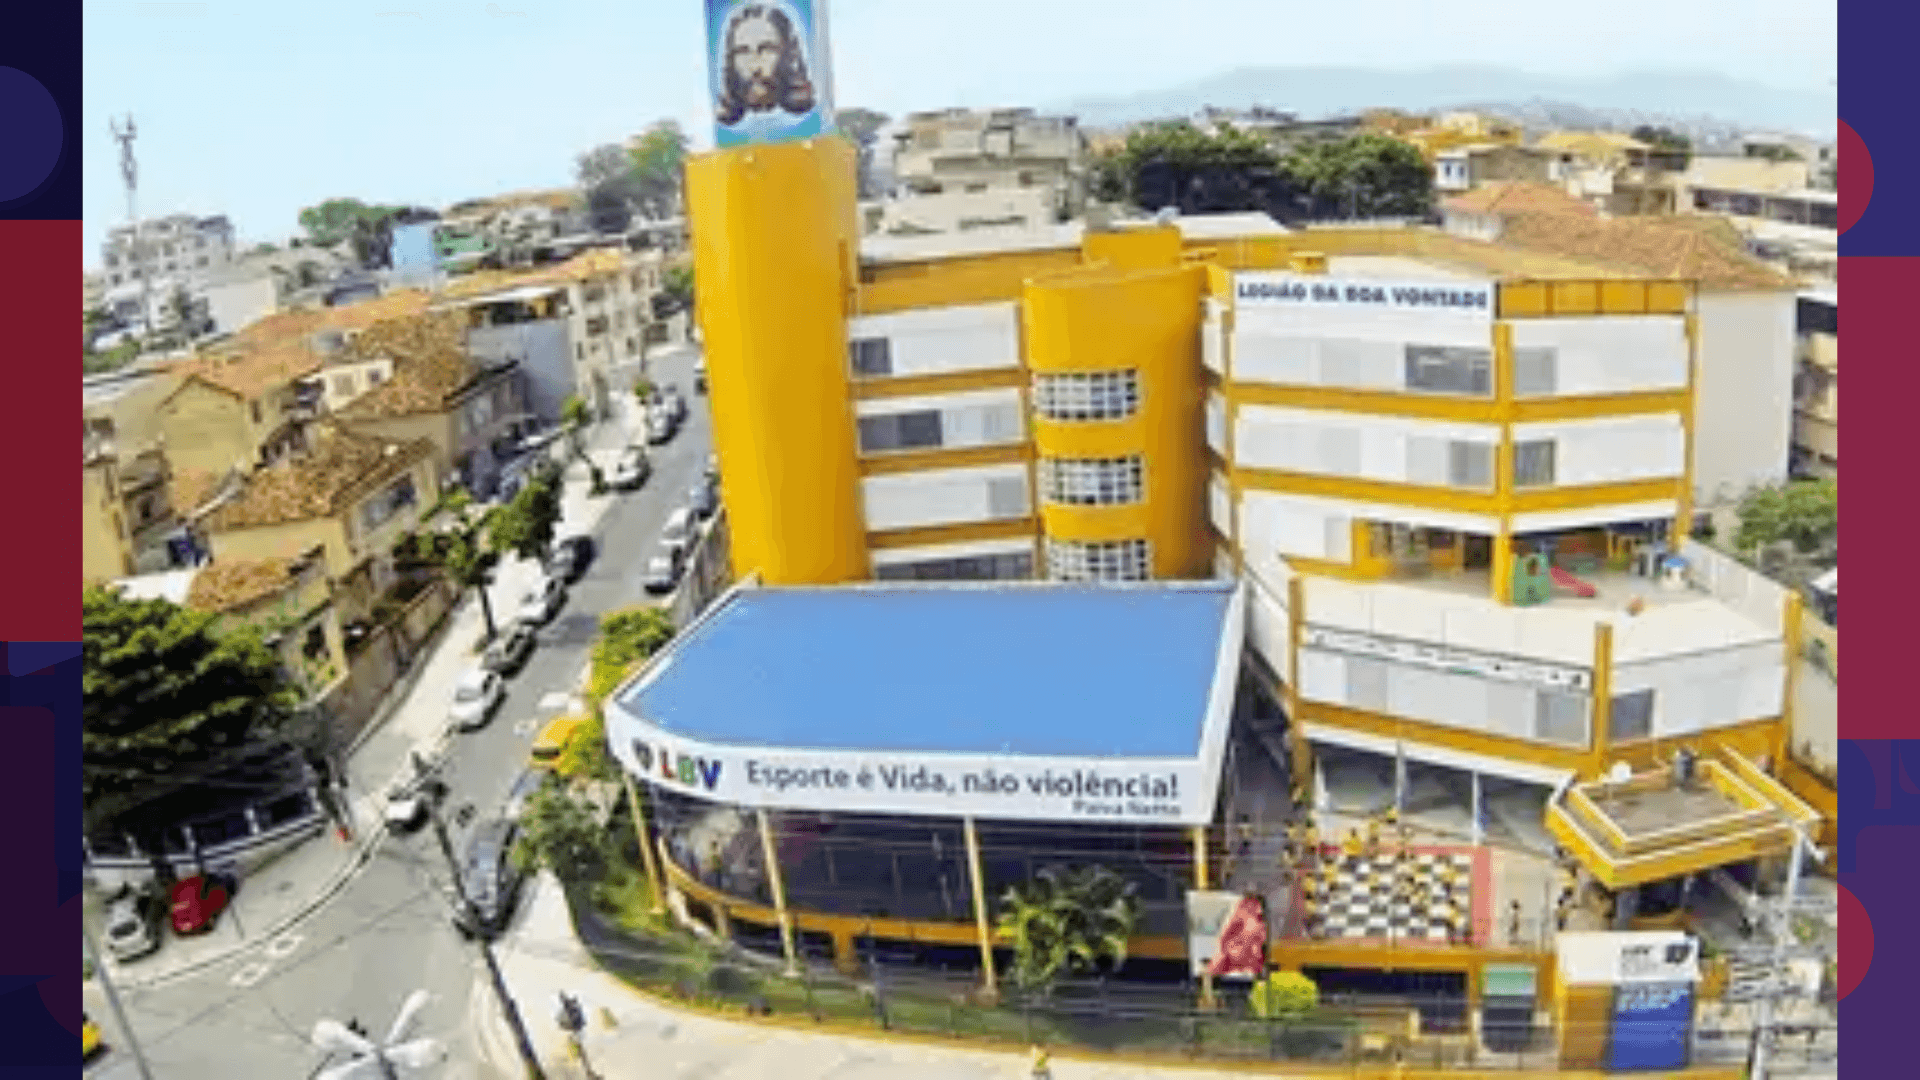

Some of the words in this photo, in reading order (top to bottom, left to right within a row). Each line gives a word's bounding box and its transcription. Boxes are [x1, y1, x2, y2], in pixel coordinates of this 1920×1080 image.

[659, 748, 722, 791] LBV
[747, 760, 850, 791] Esporte
[857, 763, 874, 788] é
[879, 764, 956, 796] Vida,
[963, 767, 1019, 793] não
[1027, 769, 1178, 798] violência!
